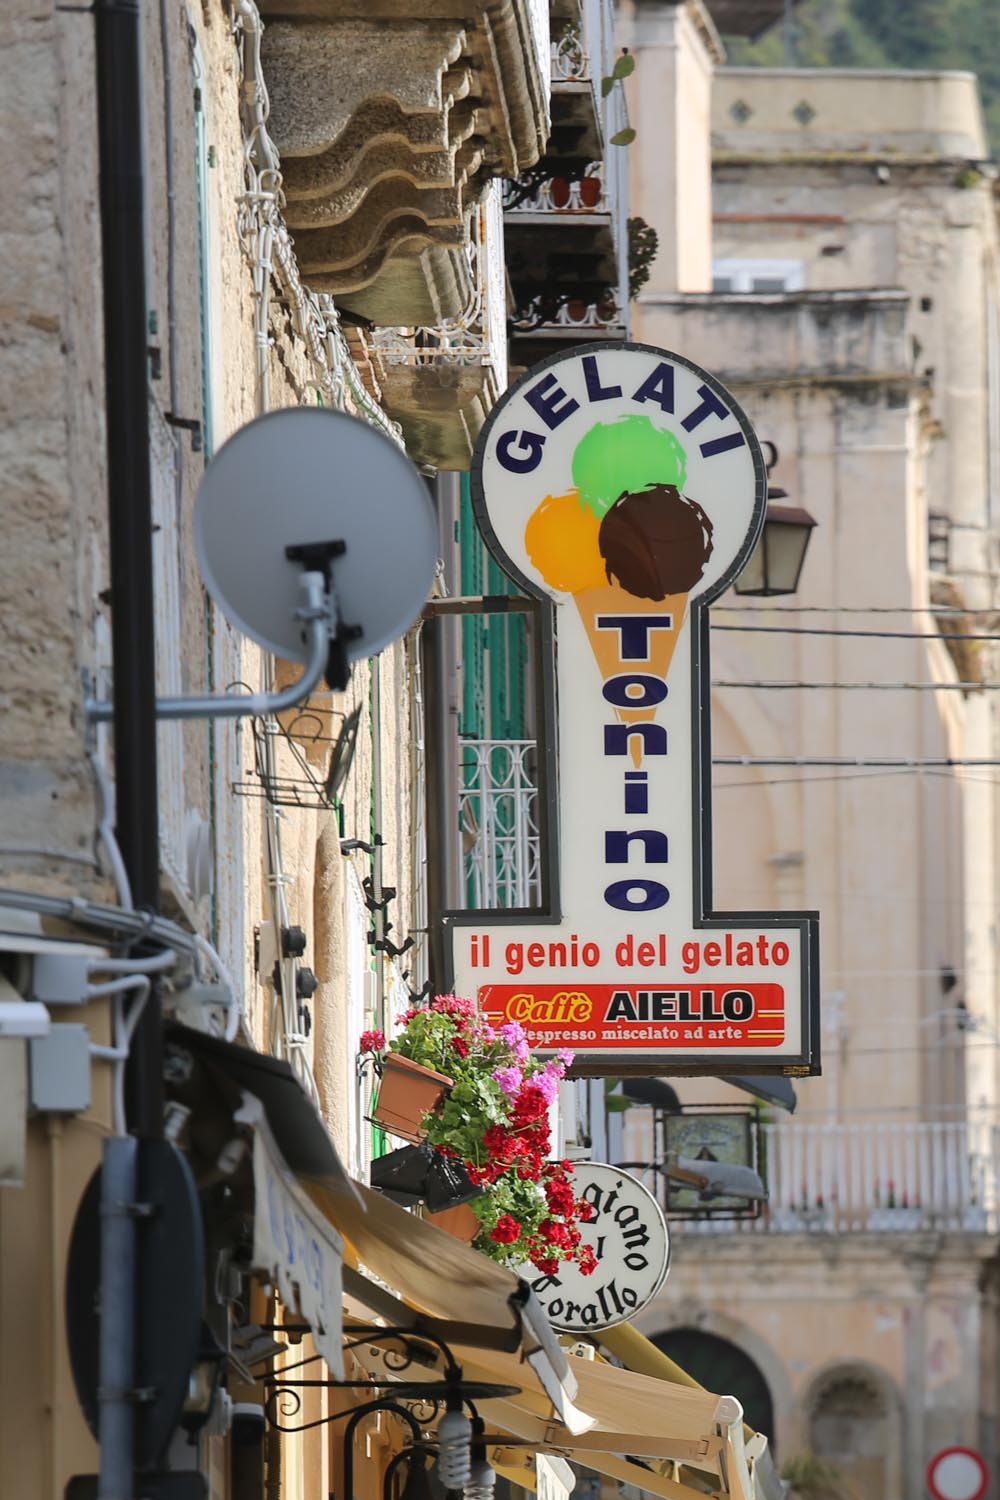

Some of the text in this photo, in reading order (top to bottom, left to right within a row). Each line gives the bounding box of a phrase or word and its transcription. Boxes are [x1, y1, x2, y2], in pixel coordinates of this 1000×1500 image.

[495, 355, 745, 474] GELATI
[597, 616, 670, 912] Tonino
[470, 933, 790, 974] il genio del gelato
[506, 992, 593, 1023] Caffè
[603, 990, 755, 1022] AIELLO
[602, 1026, 678, 1040] miscelato
[684, 1027, 703, 1039] ad
[708, 1027, 742, 1039] arte
